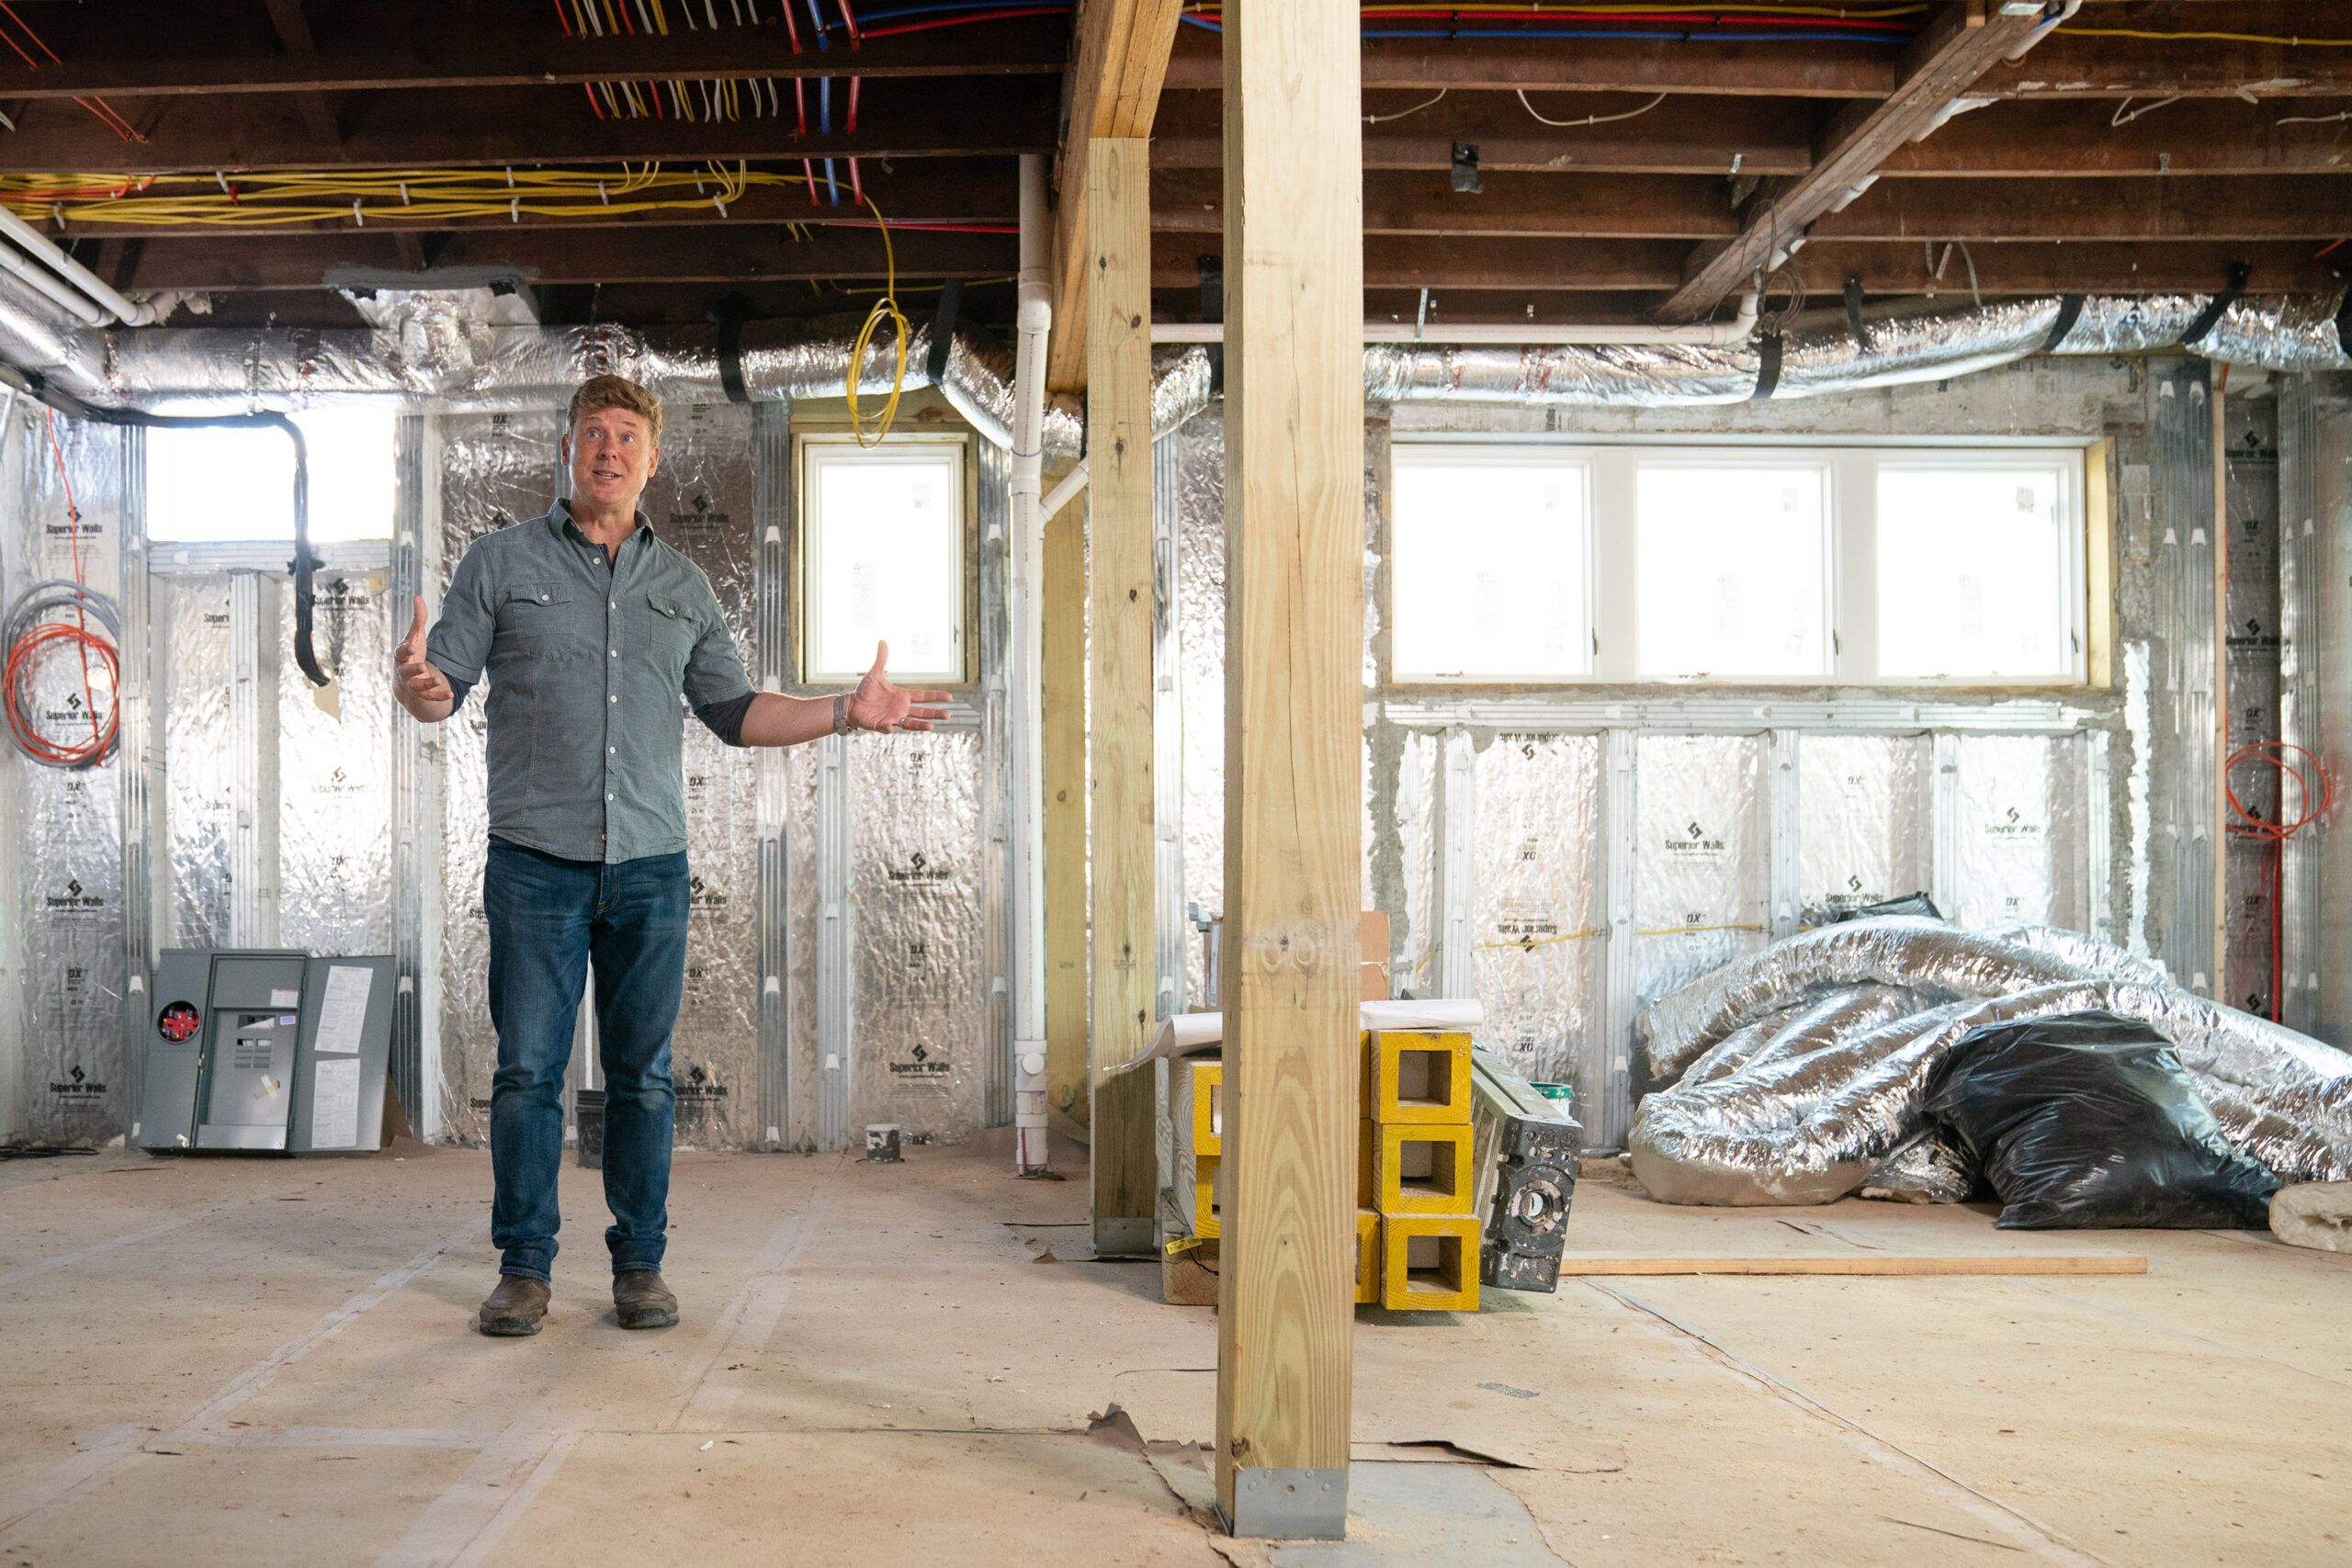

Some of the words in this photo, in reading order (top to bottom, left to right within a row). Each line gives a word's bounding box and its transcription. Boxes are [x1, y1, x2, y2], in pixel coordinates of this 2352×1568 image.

[46, 523, 79, 536] Superir
[82, 523, 103, 534] Walls
[315, 595, 346, 606] uperior
[348, 595, 370, 605] Walls
[46, 710, 79, 723] Superior
[1665, 840, 1701, 852] Superior
[1702, 840, 1724, 851] Walls
[888, 869, 924, 881] Superior
[47, 896, 81, 908] Superior
[83, 897, 104, 908] Walls
[706, 894, 728, 906] Walls
[1826, 893, 1860, 905] Superior
[1862, 893, 1884, 904] Walls
[1498, 925, 1520, 935] Walls
[1521, 924, 1557, 935] Superior
[889, 1062, 925, 1074] Superior
[927, 1062, 950, 1073] Walls
[50, 1082, 84, 1094] Superior
[85, 1082, 107, 1093] Walls
[705, 1085, 728, 1096] Walls
